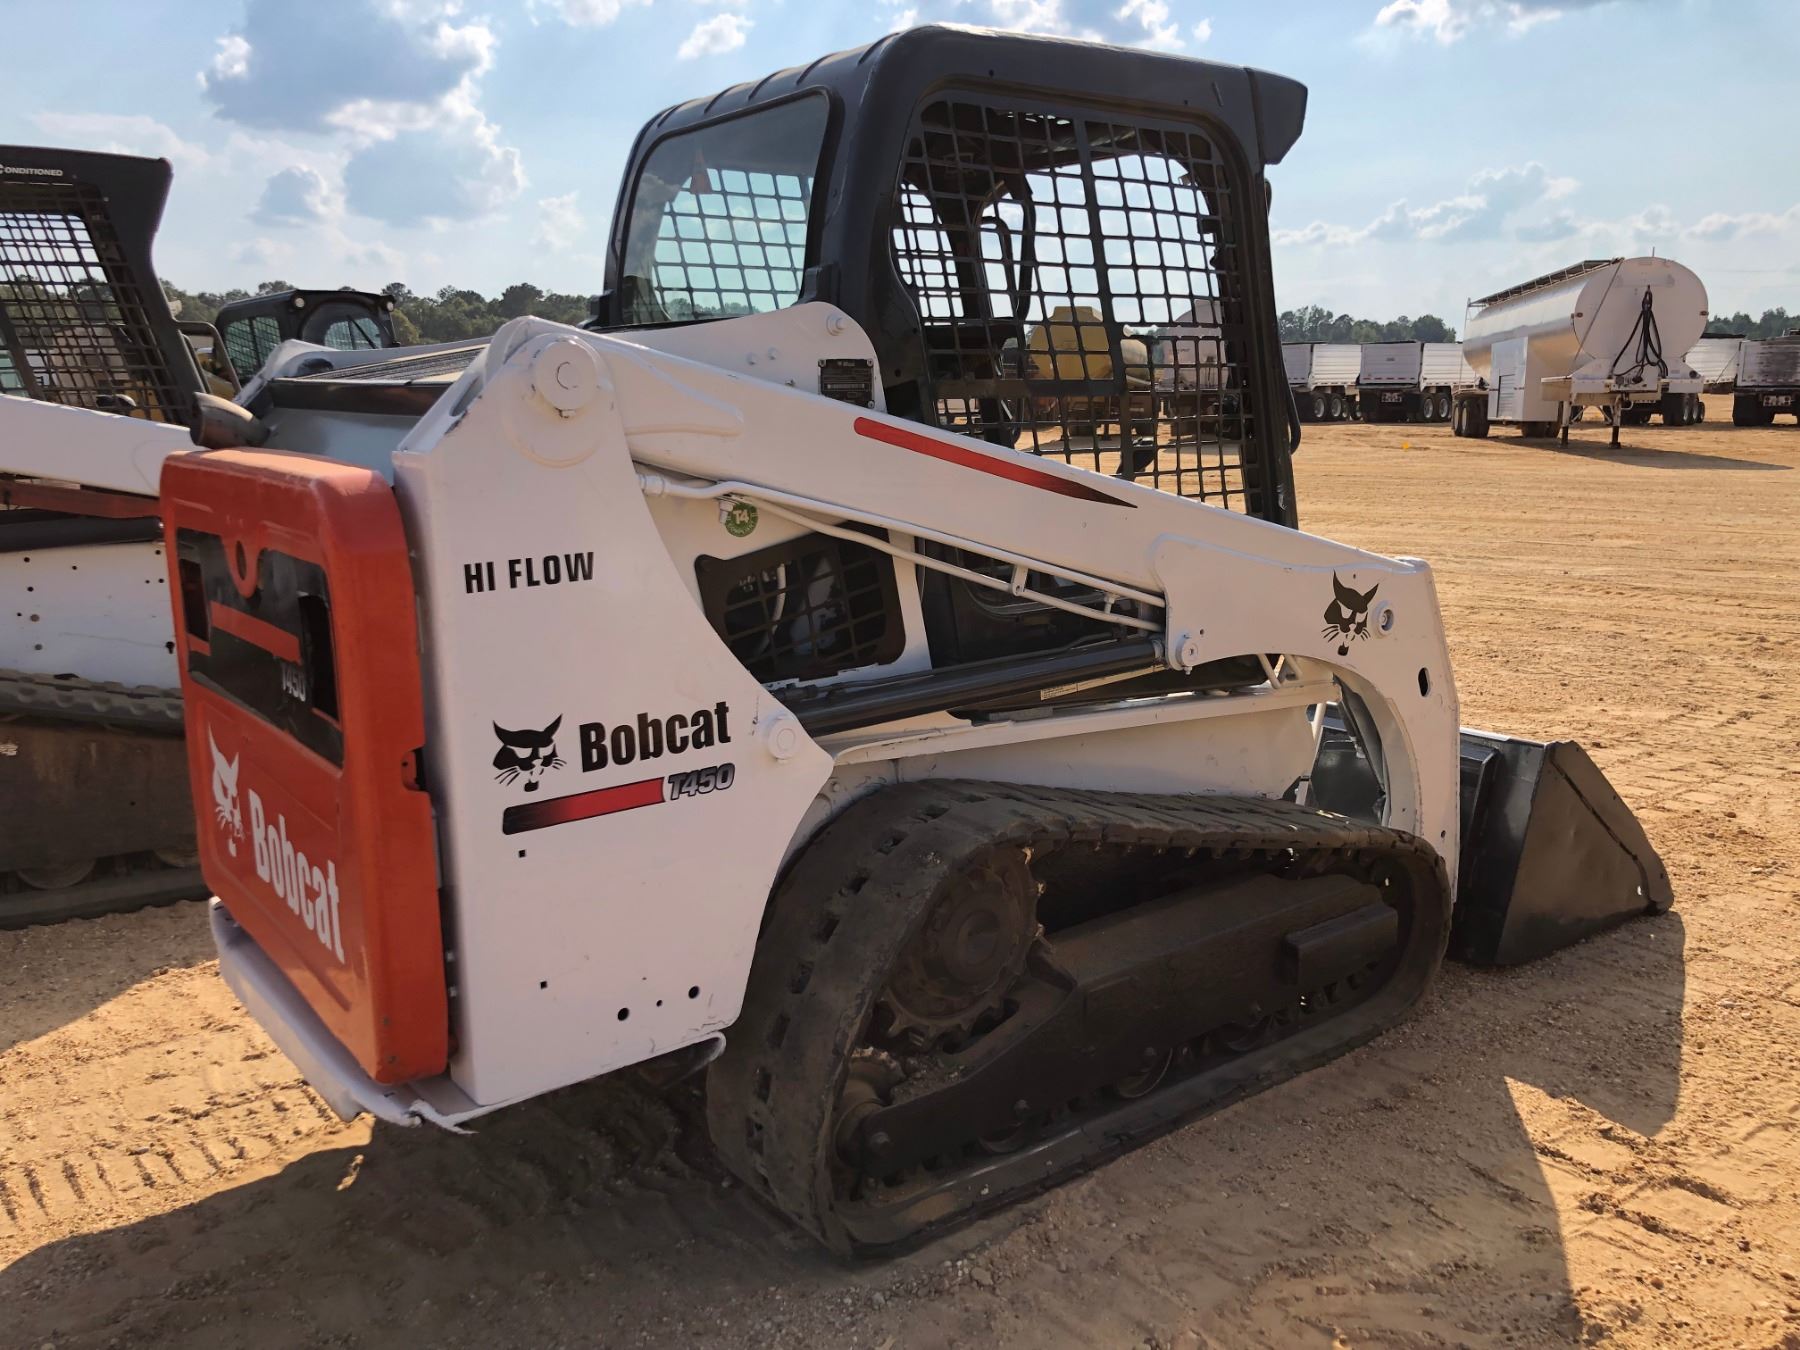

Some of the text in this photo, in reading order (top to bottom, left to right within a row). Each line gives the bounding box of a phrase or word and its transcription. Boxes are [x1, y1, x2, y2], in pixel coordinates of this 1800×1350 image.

[464, 551, 594, 594] HI FLOW
[579, 701, 731, 773] Bobcat
[668, 762, 736, 801] T450
[248, 788, 346, 965] Bobcat
